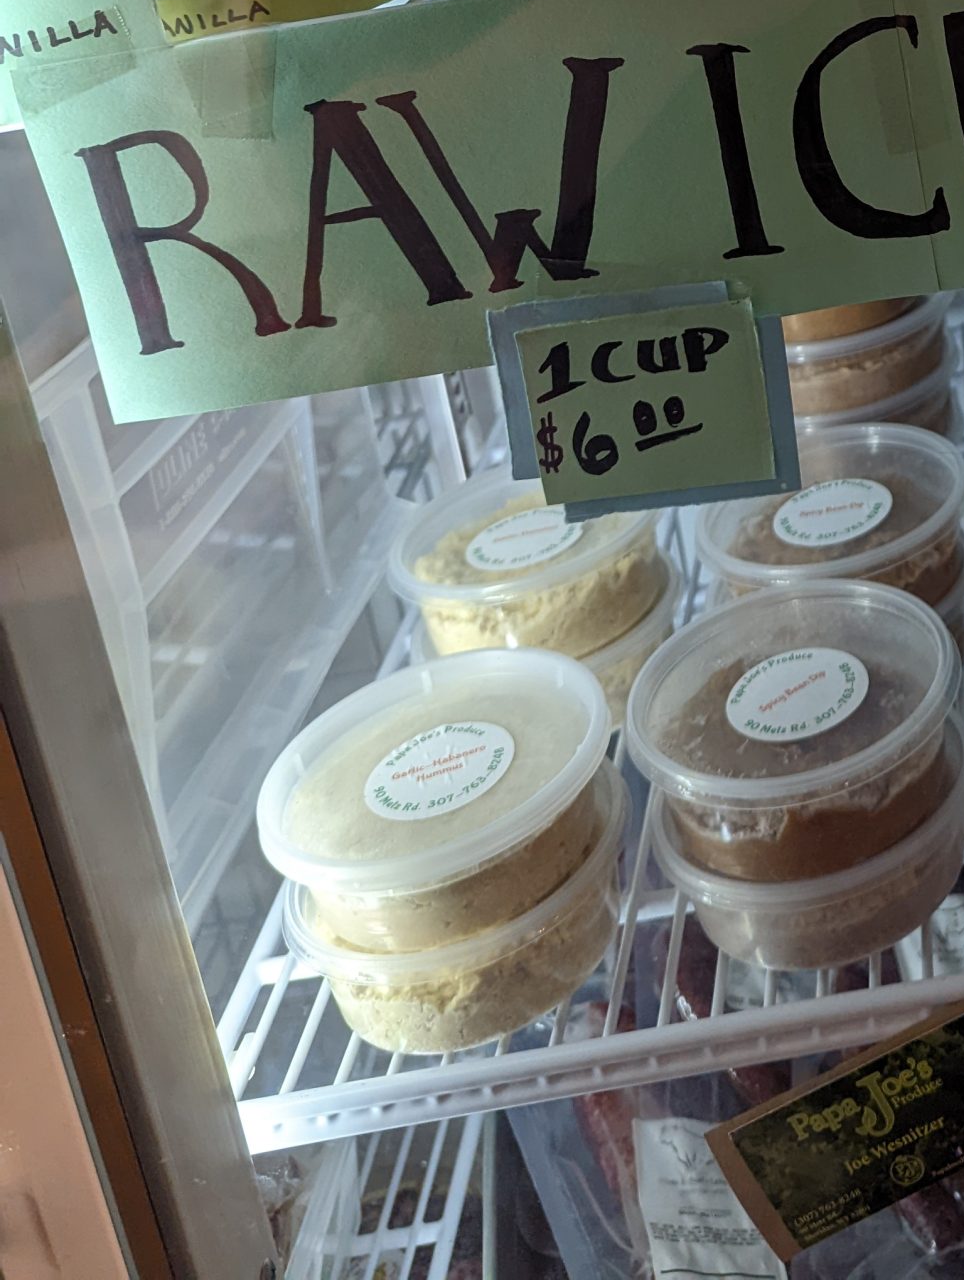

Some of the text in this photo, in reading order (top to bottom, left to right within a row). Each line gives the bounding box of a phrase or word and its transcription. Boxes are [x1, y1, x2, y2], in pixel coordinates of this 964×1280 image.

[164, 0, 270, 36] ANILLA
[74, 57, 625, 357] RAW
[536, 327, 730, 404] 1 CUP
[768, 652, 813, 669] Produce
[386, 725, 486, 767] Papa Joe's Produce
[416, 762, 464, 782] Hummus
[402, 801, 421, 811] Rd.
[427, 746, 505, 809] 307-763-8248
[786, 1057, 934, 1141] Papa Joe's
[891, 1076, 943, 1110] Produce
[844, 1154, 870, 1177] Joe
[871, 1114, 945, 1159] Wesnitzer
